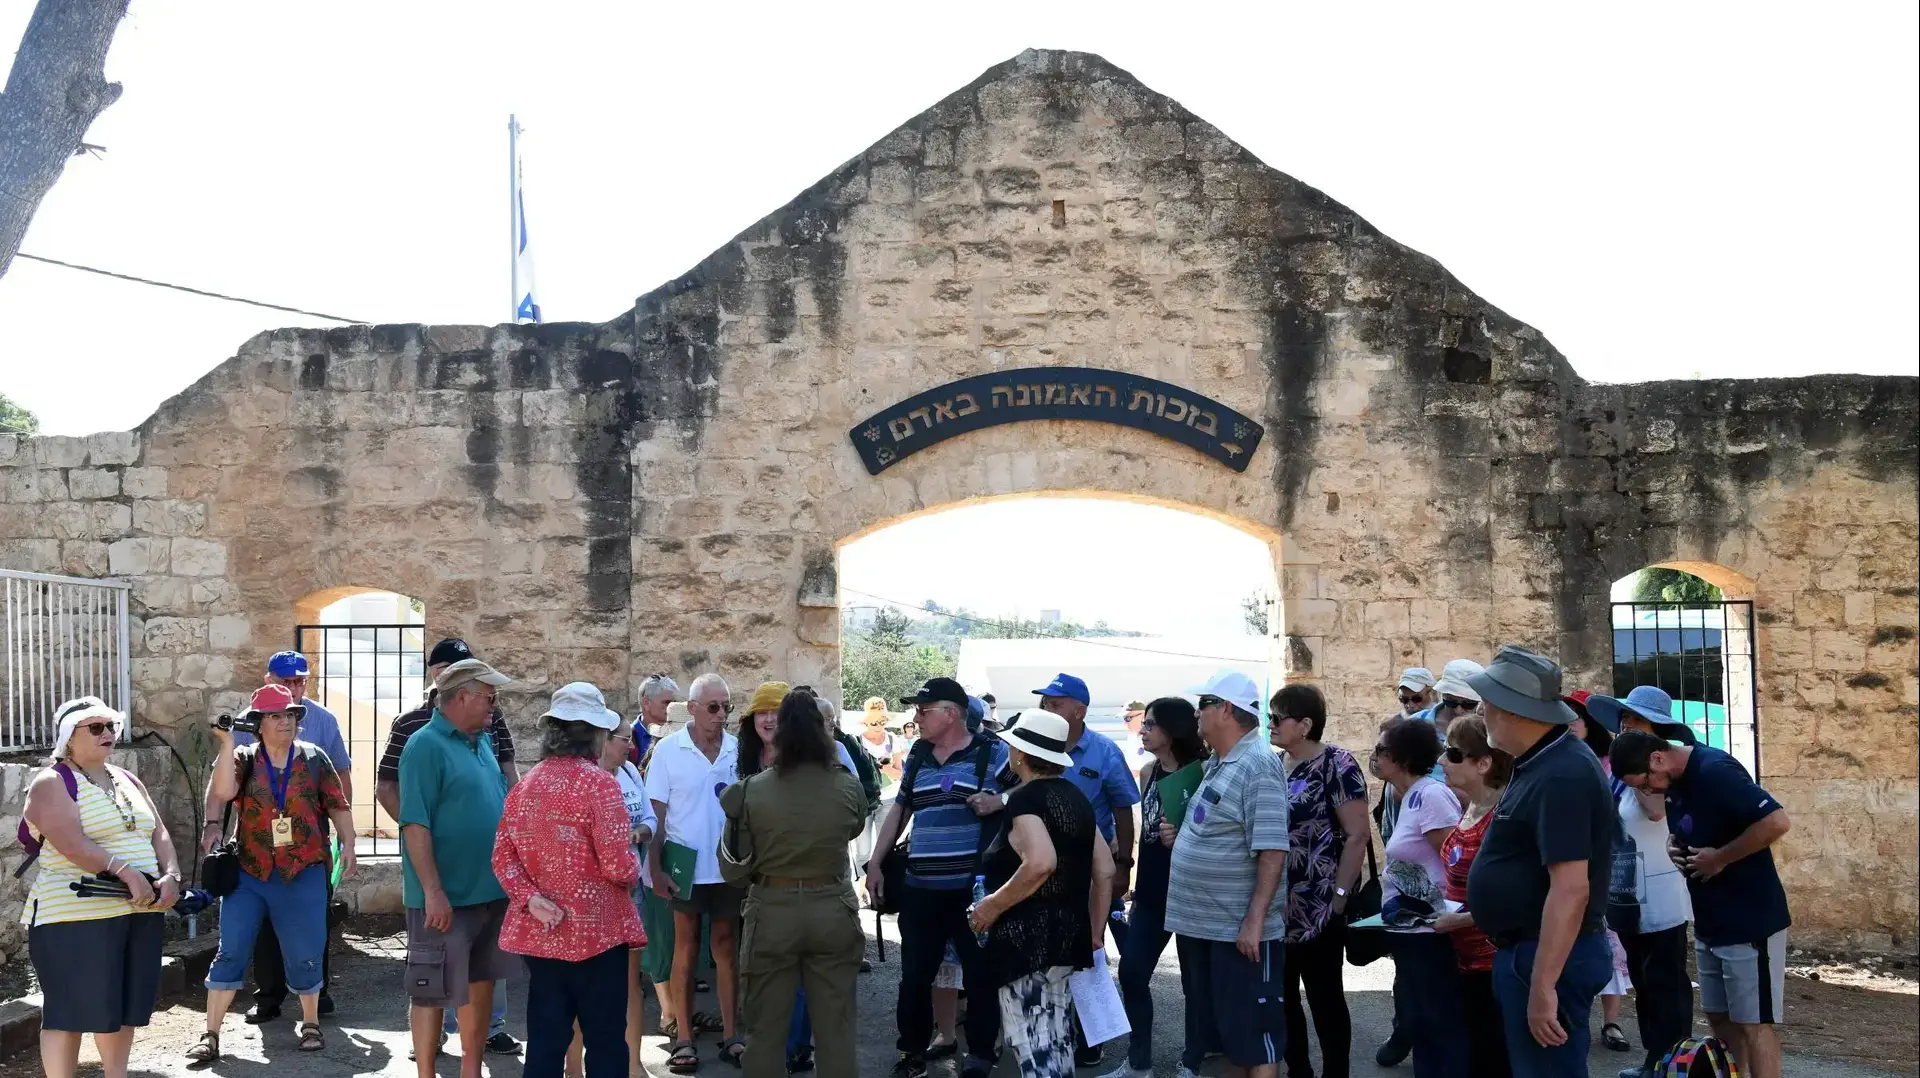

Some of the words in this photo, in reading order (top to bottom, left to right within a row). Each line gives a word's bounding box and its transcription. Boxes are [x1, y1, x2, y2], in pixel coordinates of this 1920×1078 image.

[887, 392, 981, 442] באדם
[991, 383, 1117, 409] האמונה
[1127, 388, 1219, 437] בזכות
